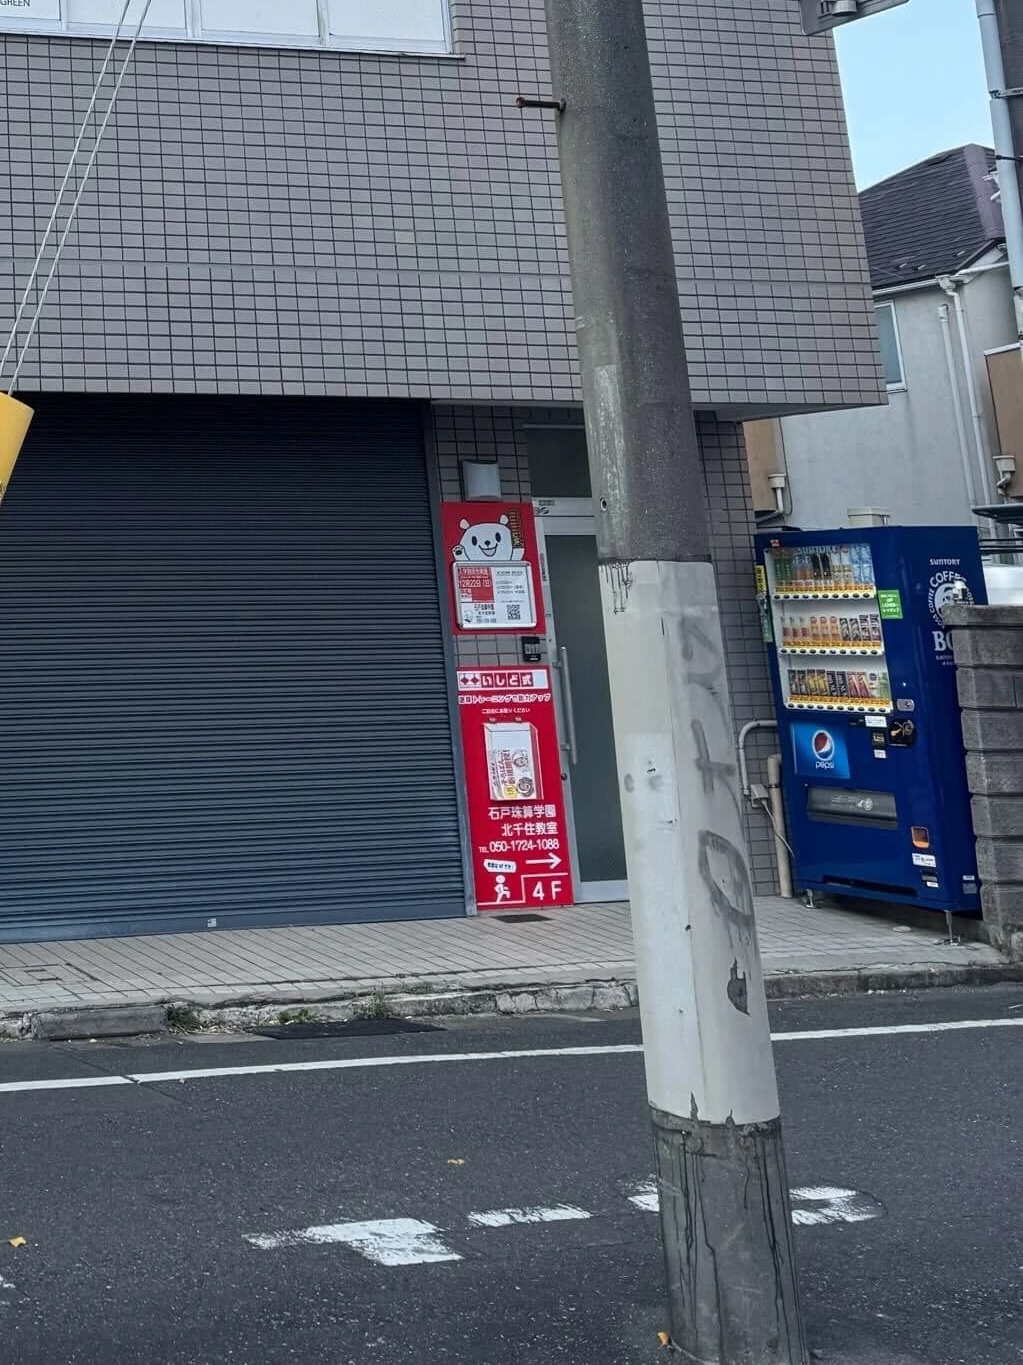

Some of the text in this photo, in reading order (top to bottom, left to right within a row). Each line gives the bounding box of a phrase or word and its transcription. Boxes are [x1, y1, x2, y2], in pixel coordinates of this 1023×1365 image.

[481, 673, 532, 687] いしど式
[815, 761, 834, 769] pepsi
[501, 822, 559, 837] 北千住教室
[489, 838, 560, 853] 050-1724-1088
